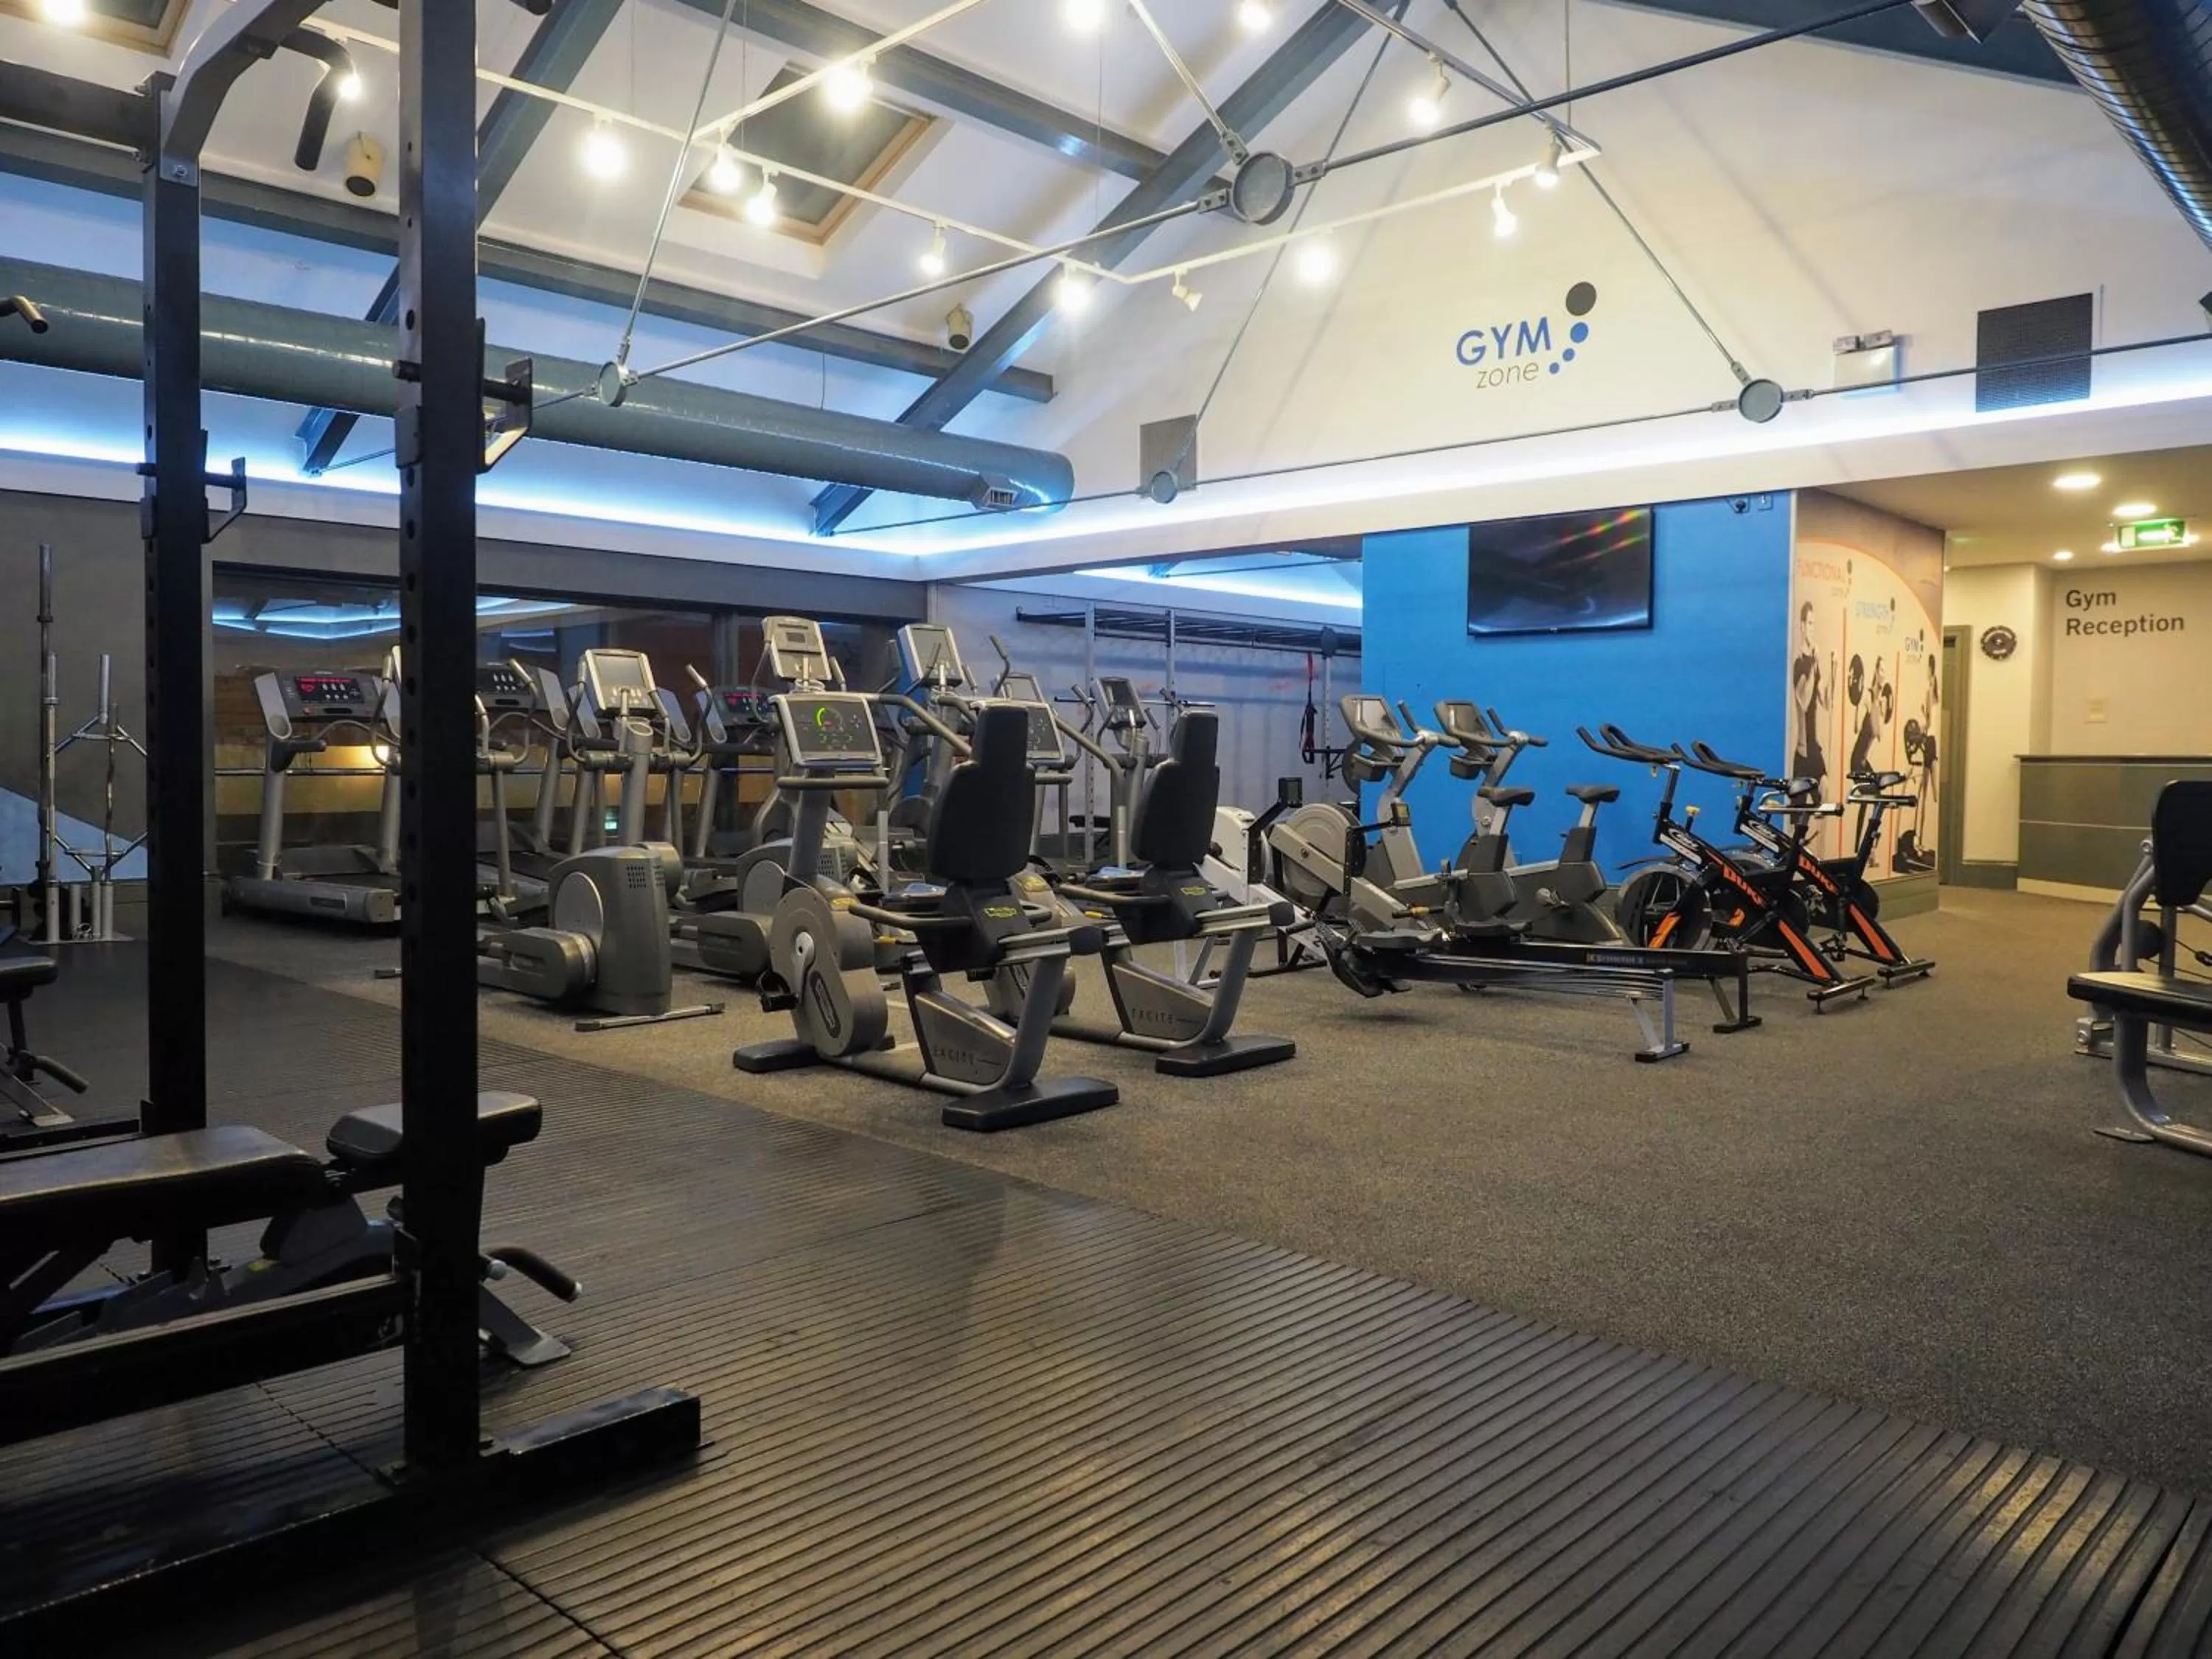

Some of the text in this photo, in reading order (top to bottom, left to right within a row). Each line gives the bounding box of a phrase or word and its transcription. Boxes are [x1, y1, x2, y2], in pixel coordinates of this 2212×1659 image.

[1456, 316, 1551, 366] GYM
[1477, 362, 1540, 389] zone
[2066, 589, 2116, 612] Gym
[2066, 613, 2185, 638] Reception
